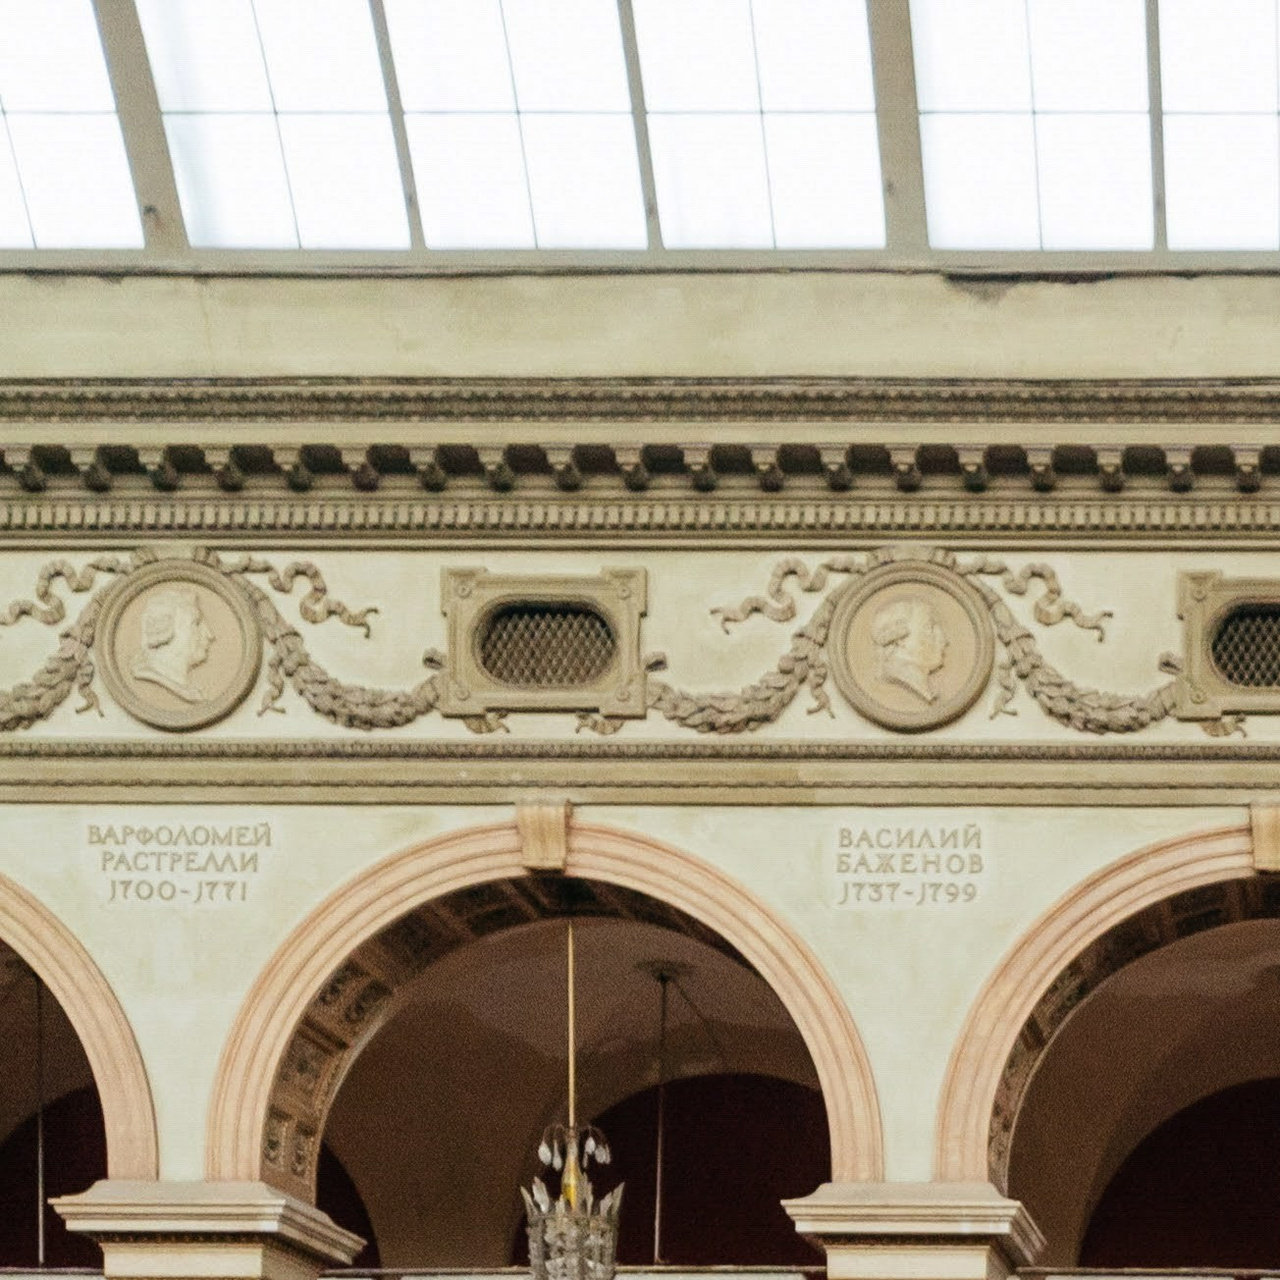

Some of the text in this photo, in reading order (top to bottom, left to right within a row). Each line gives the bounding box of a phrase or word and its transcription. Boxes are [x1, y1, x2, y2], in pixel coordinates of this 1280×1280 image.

[87, 822, 272, 847] ВАРФОЛОМЕЙ
[838, 823, 983, 849] ВАСИЛИЙ
[100, 851, 259, 873] РАСТРЕЛЛИ
[835, 852, 984, 874] БАЖЕНОВ
